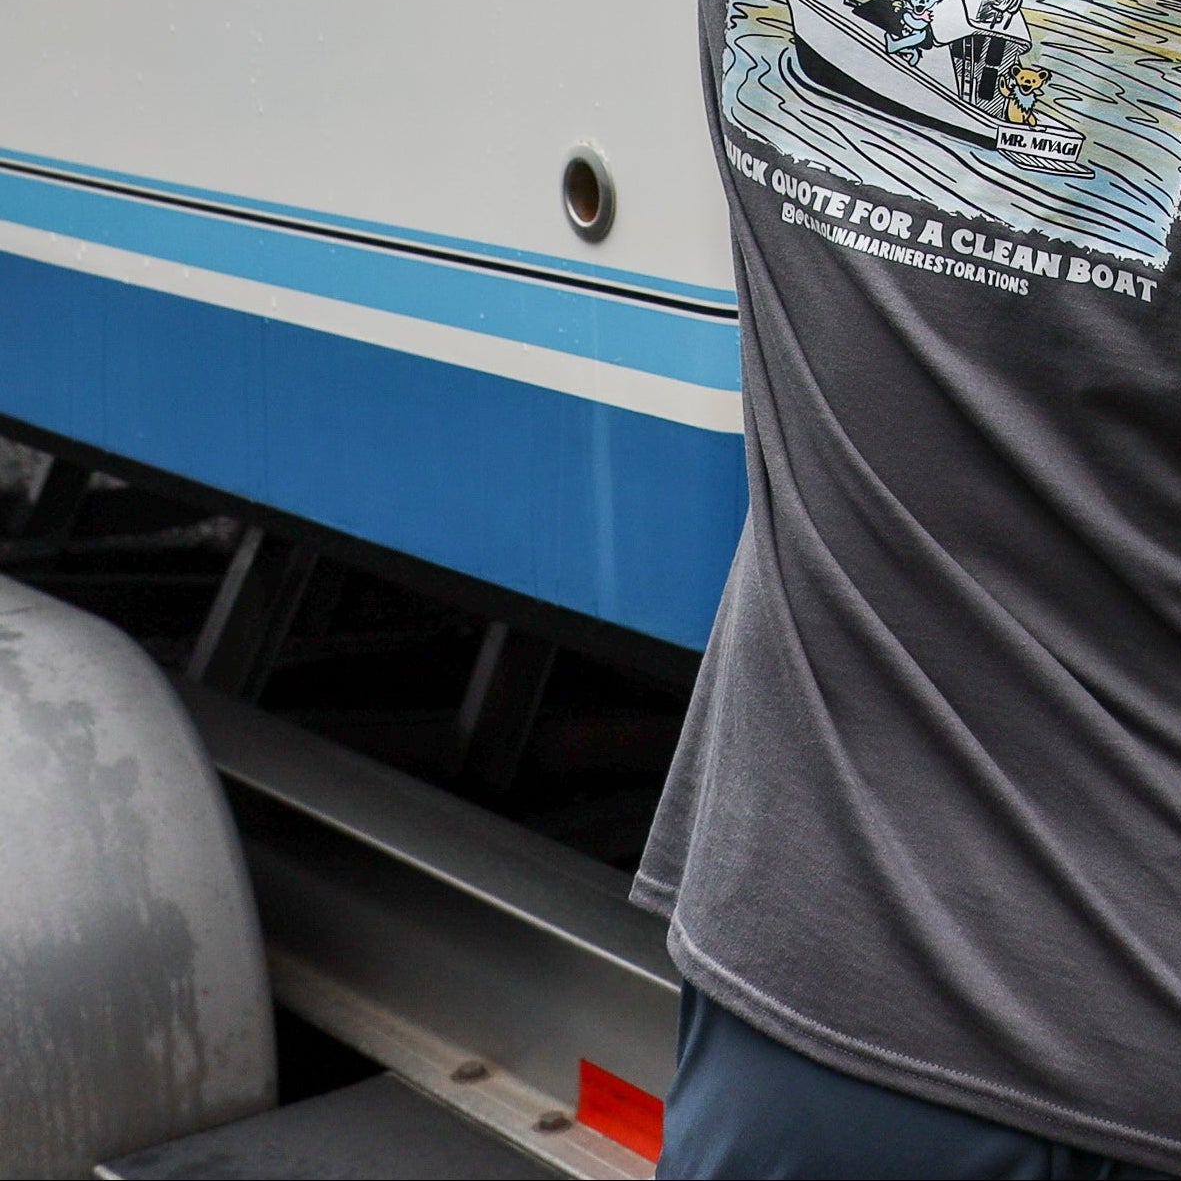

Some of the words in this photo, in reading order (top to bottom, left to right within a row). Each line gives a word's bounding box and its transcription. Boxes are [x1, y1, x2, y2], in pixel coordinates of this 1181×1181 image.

[1000, 132, 1027, 148] MR.
[1031, 136, 1078, 156] MIYAGI
[771, 168, 851, 218] QUOTE
[849, 198, 913, 240] FOR
[917, 220, 944, 247] A
[951, 229, 1062, 278] CLEAN
[1066, 256, 1158, 302] BOAT
